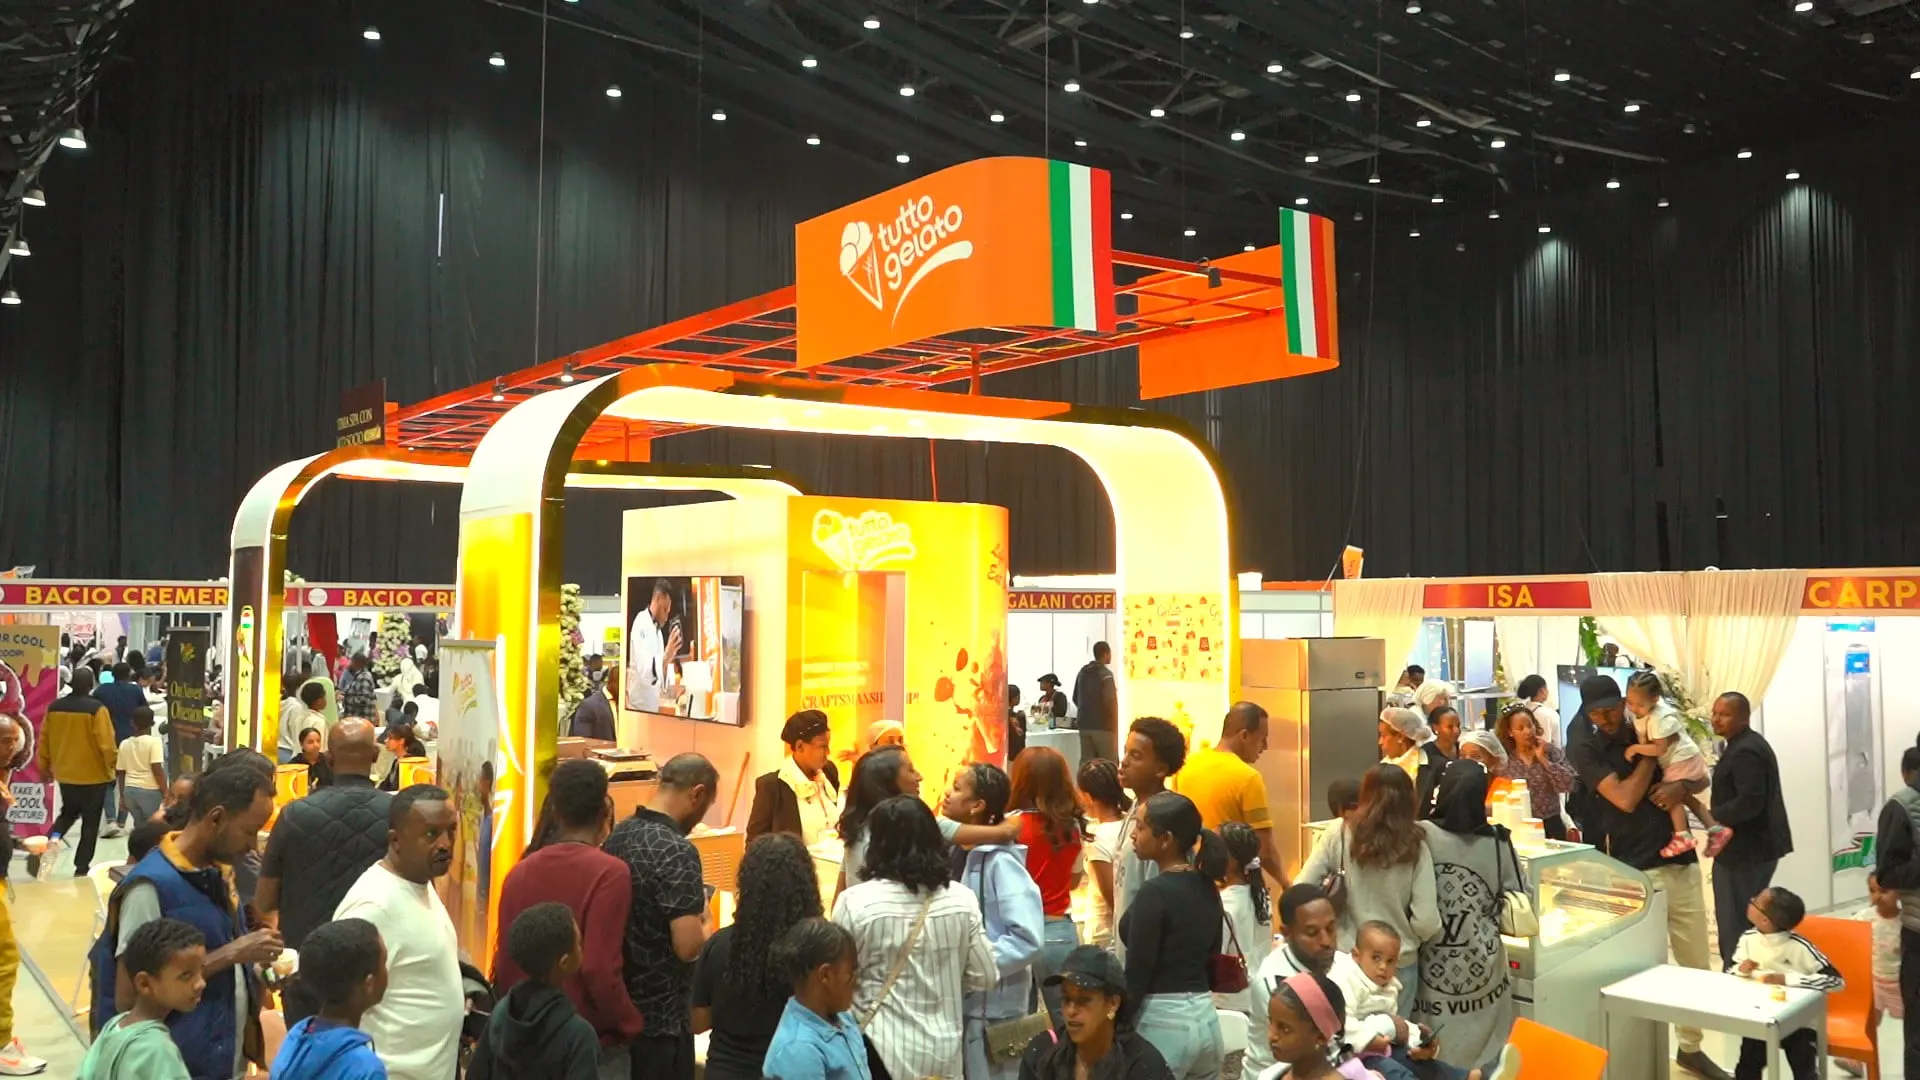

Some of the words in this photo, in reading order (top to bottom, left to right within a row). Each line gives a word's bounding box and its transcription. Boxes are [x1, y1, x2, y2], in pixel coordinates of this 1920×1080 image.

[877, 195, 934, 252] tutto
[884, 205, 963, 290] gelato
[25, 586, 112, 605] BACIO
[343, 590, 413, 607] BACIO
[1008, 592, 1066, 609] GALANI
[1488, 584, 1535, 608] ISA
[1808, 579, 1918, 608] CARP
[13, 633, 45, 648] COOL
[1446, 971, 1512, 1017] VUITTON
